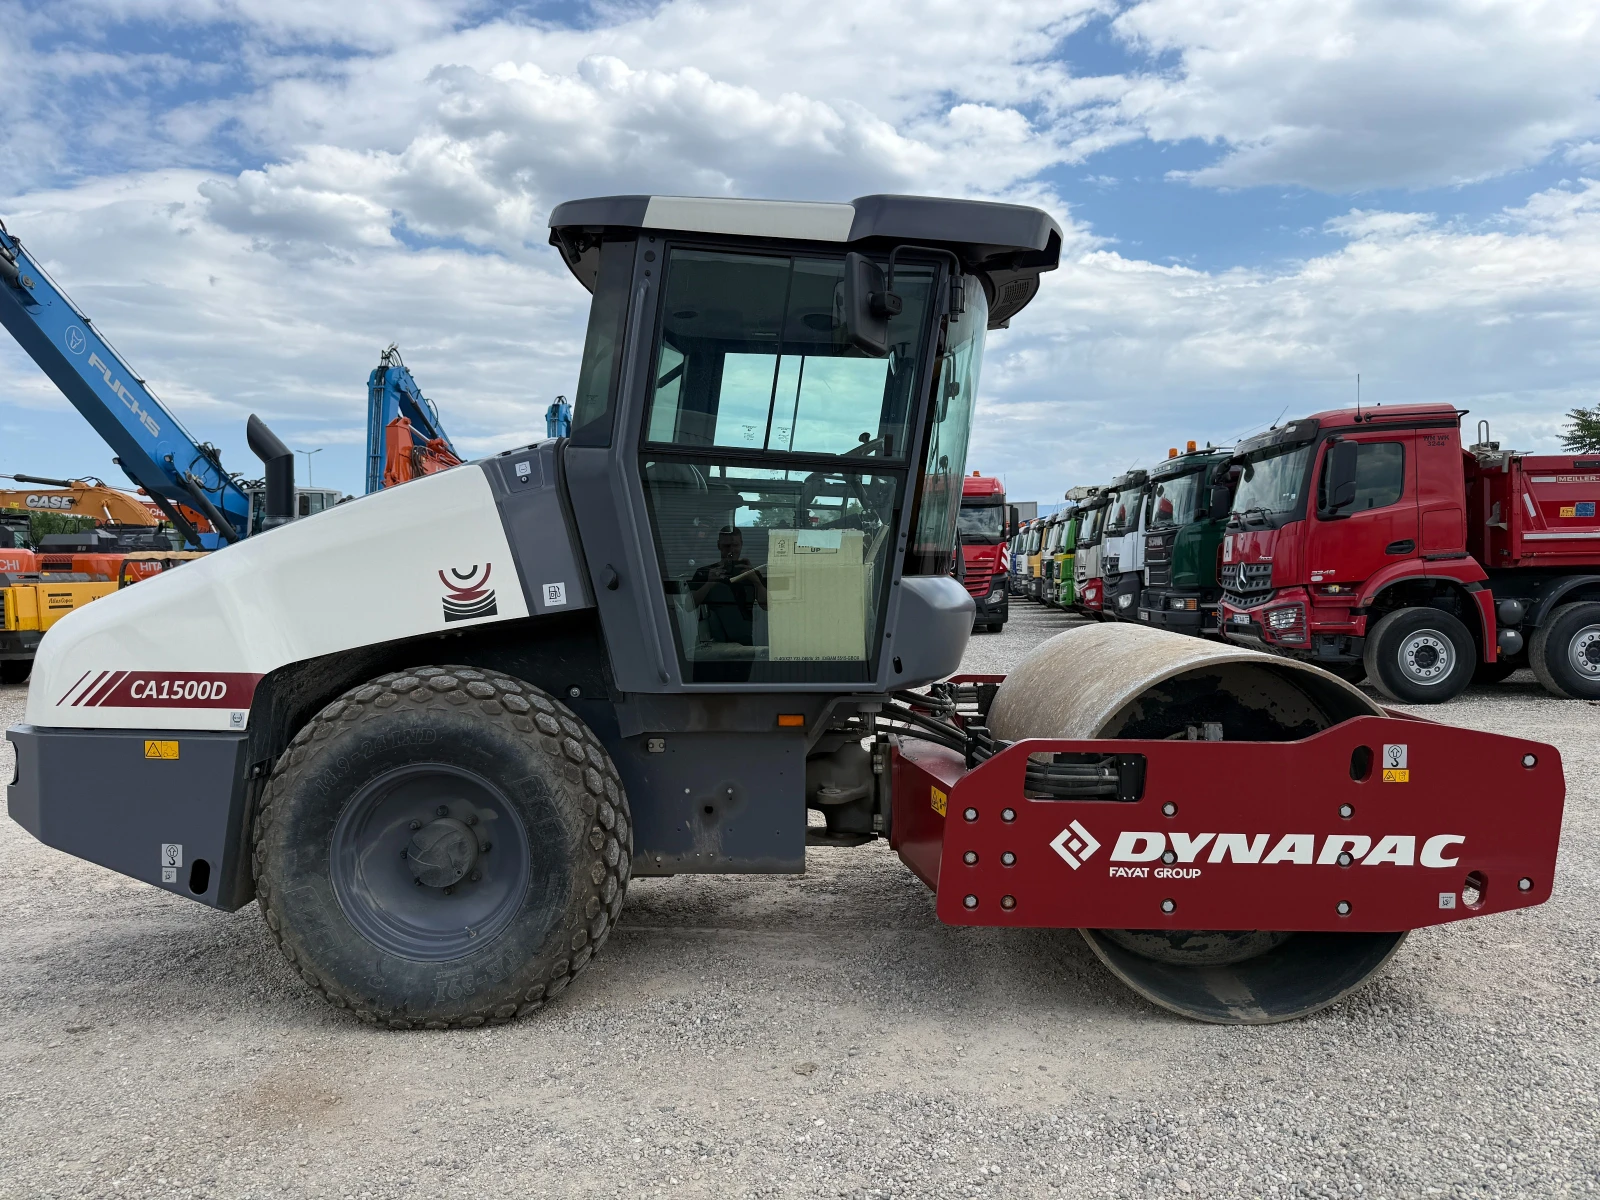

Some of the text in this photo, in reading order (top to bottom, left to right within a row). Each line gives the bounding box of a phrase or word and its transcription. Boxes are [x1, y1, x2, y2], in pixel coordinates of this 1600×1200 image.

[88, 352, 160, 438] FUCHS
[25, 494, 74, 509] CASE
[130, 680, 227, 699] CA1500D
[1110, 831, 1466, 868] DYNAPAC
[1109, 866, 1202, 879] FAYAT GROUP
